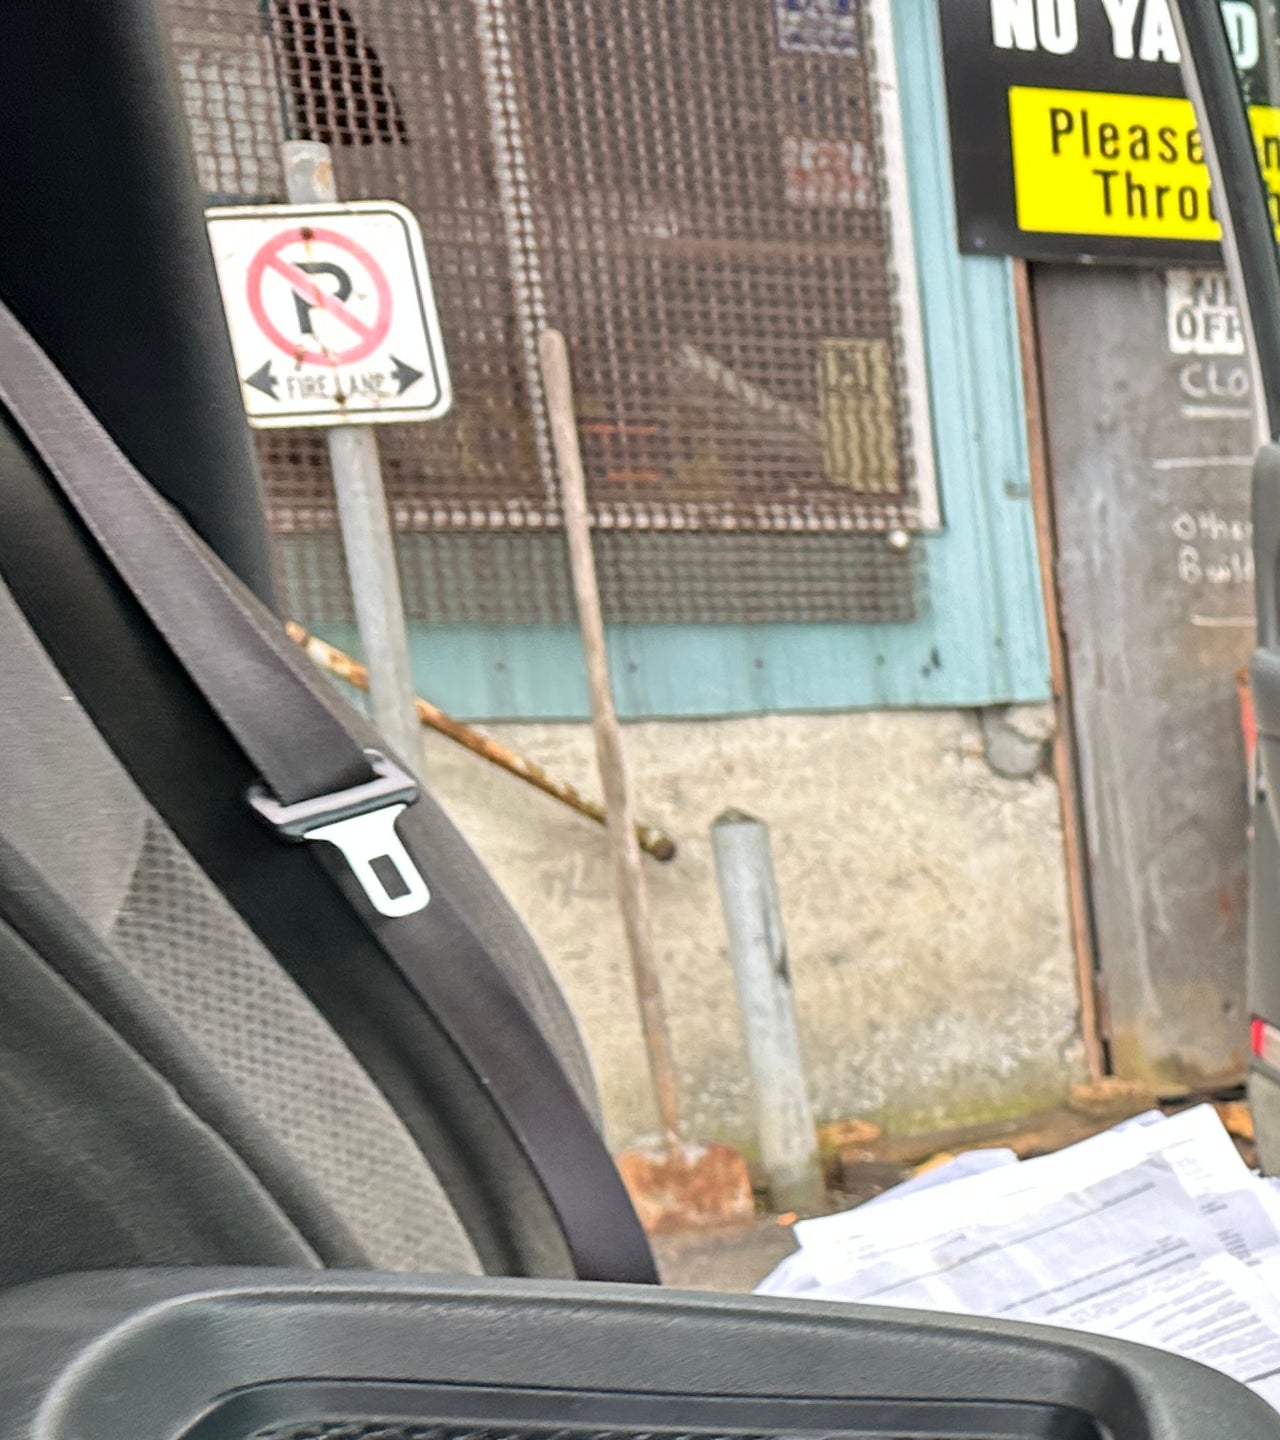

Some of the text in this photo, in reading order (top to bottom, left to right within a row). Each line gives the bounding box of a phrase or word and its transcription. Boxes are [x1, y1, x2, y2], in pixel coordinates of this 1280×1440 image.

[990, 0, 1079, 54] NO
[1103, 0, 1259, 69] YAD
[1049, 107, 1207, 166] Please
[286, 375, 332, 399] FIRE
